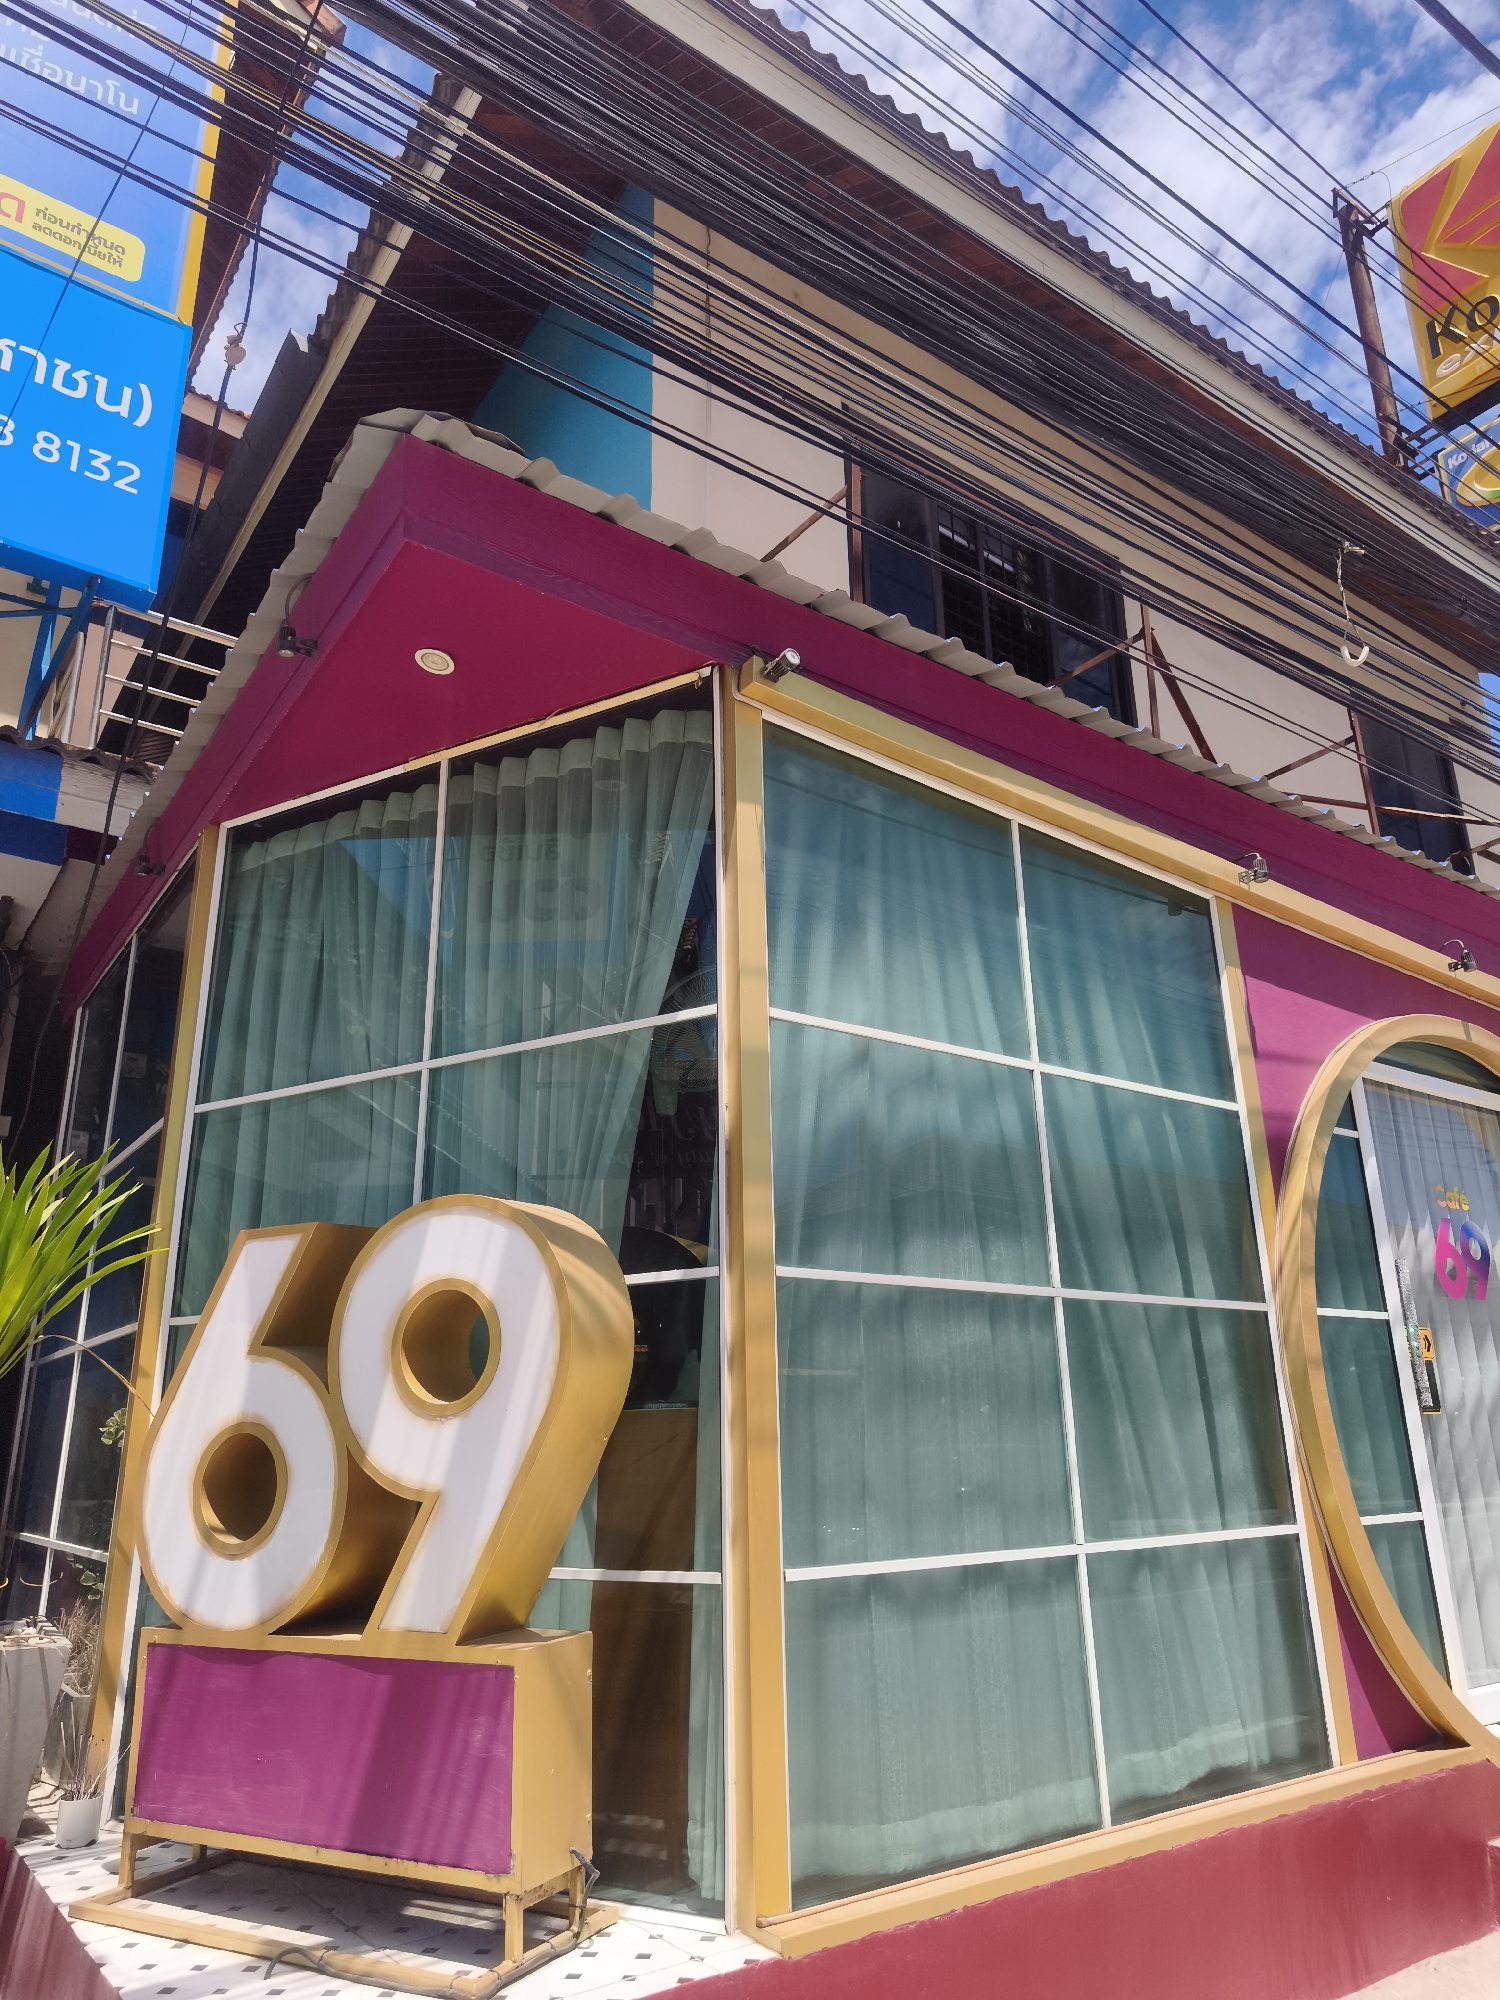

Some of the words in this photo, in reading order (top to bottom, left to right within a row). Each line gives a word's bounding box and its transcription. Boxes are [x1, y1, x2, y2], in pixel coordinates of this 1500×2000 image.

[31, 430, 141, 495] 8132
[1434, 1217, 1491, 1301] 69
[136, 1194, 572, 1640] 69
